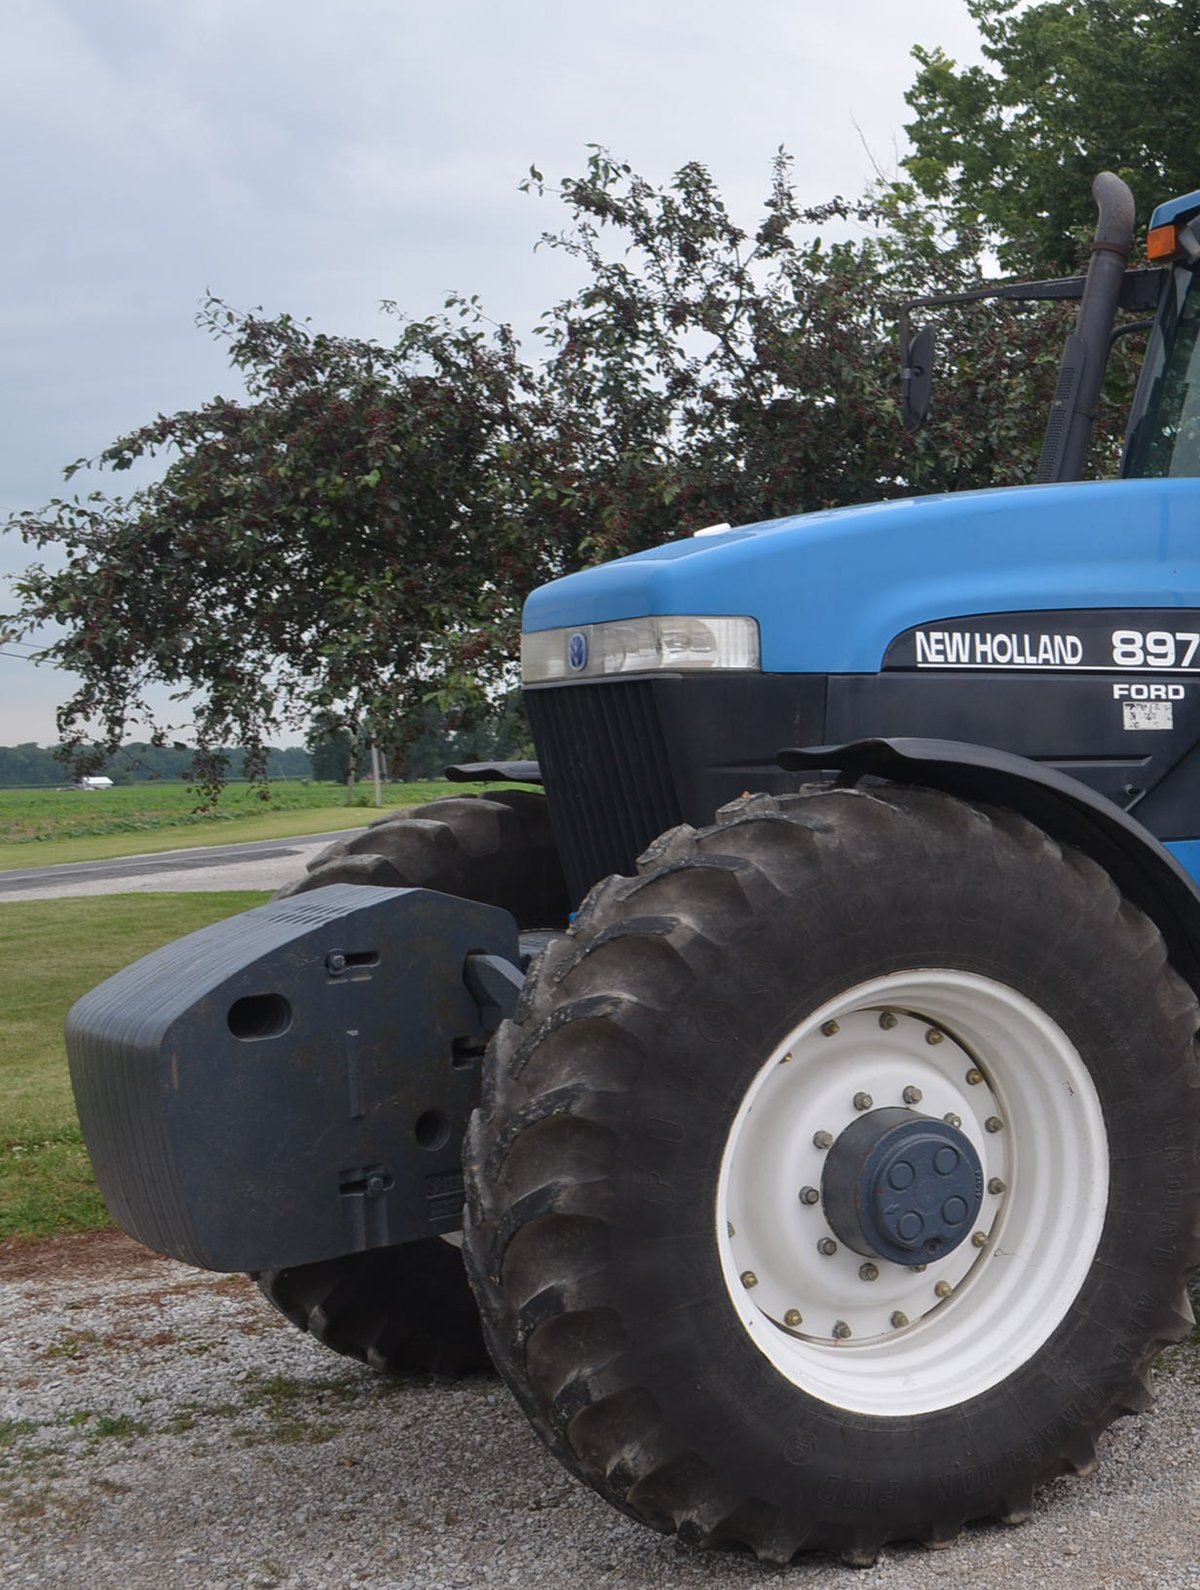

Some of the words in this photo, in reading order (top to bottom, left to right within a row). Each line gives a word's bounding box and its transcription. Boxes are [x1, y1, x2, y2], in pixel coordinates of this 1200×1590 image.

[915, 631, 970, 663] NEW
[975, 632, 1083, 664] HOLLAND
[1112, 684, 1185, 700] FORD
